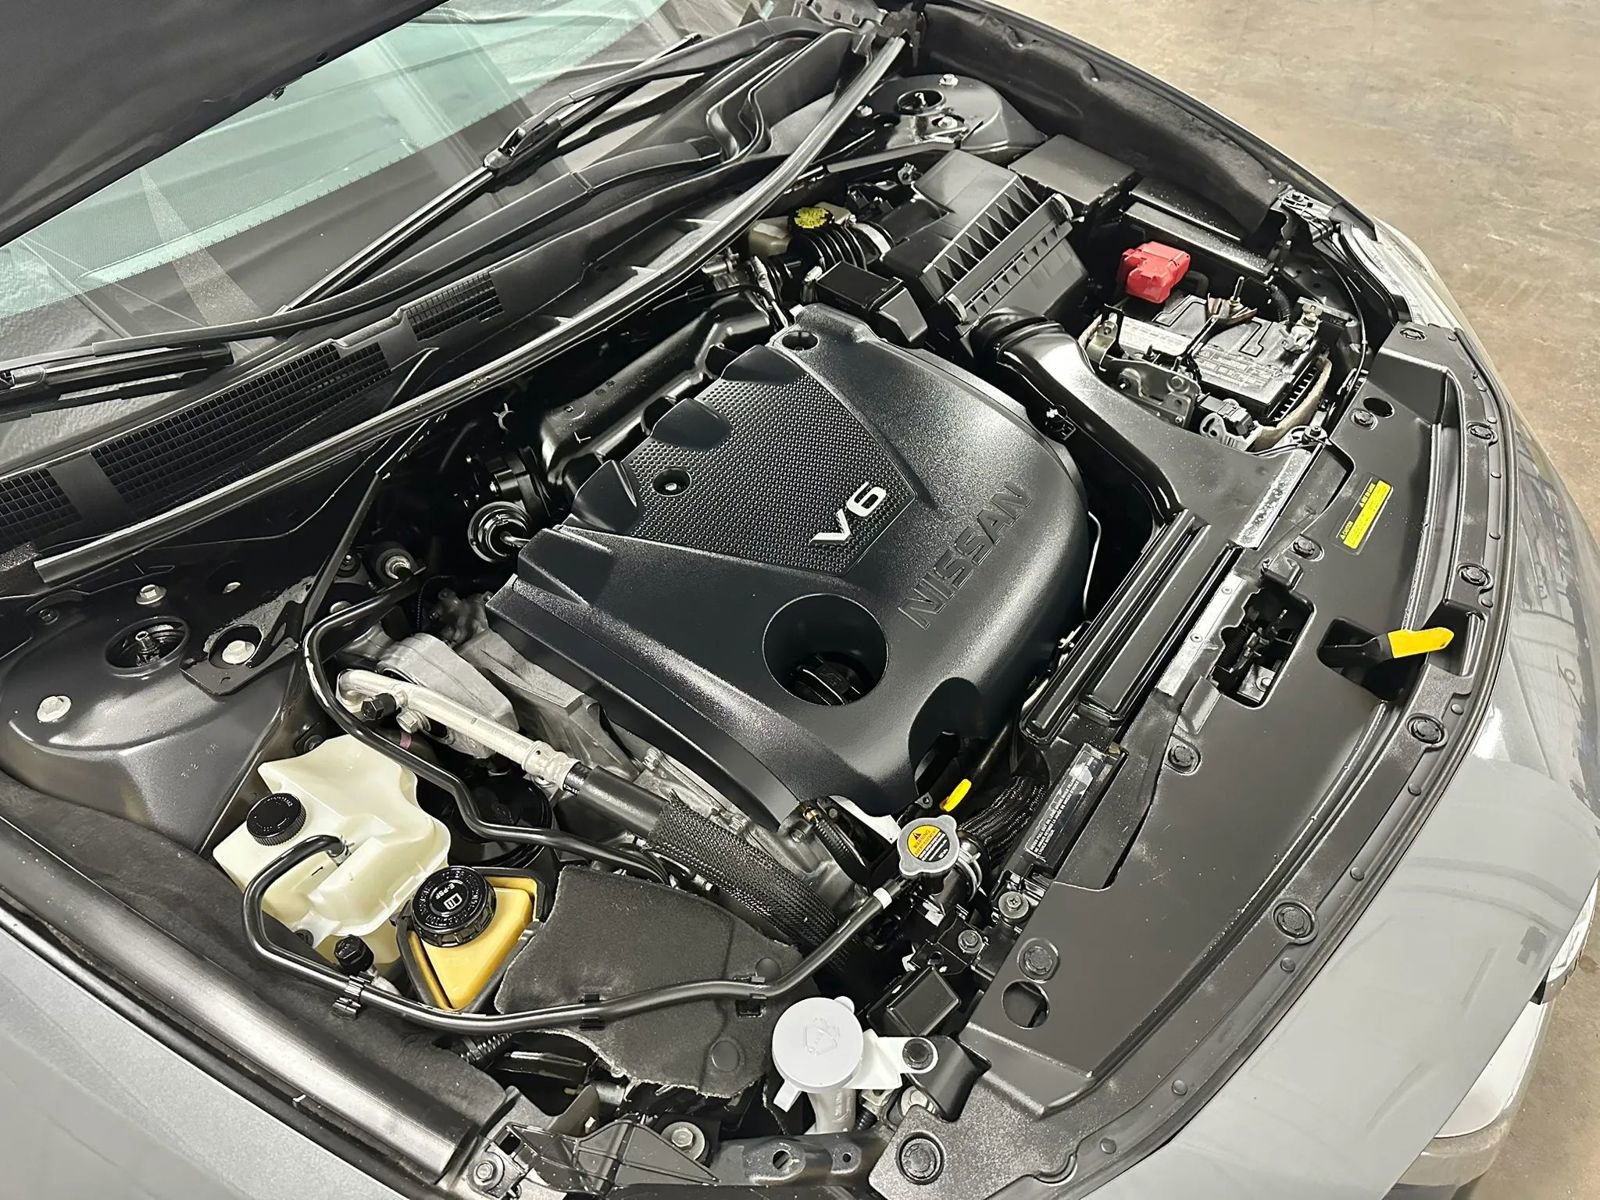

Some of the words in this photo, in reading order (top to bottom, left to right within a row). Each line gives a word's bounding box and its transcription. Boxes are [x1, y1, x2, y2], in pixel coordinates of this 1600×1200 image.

[809, 481, 887, 545] V6
[898, 481, 1033, 631] NISSAN
[435, 882, 456, 900] E-PSF
